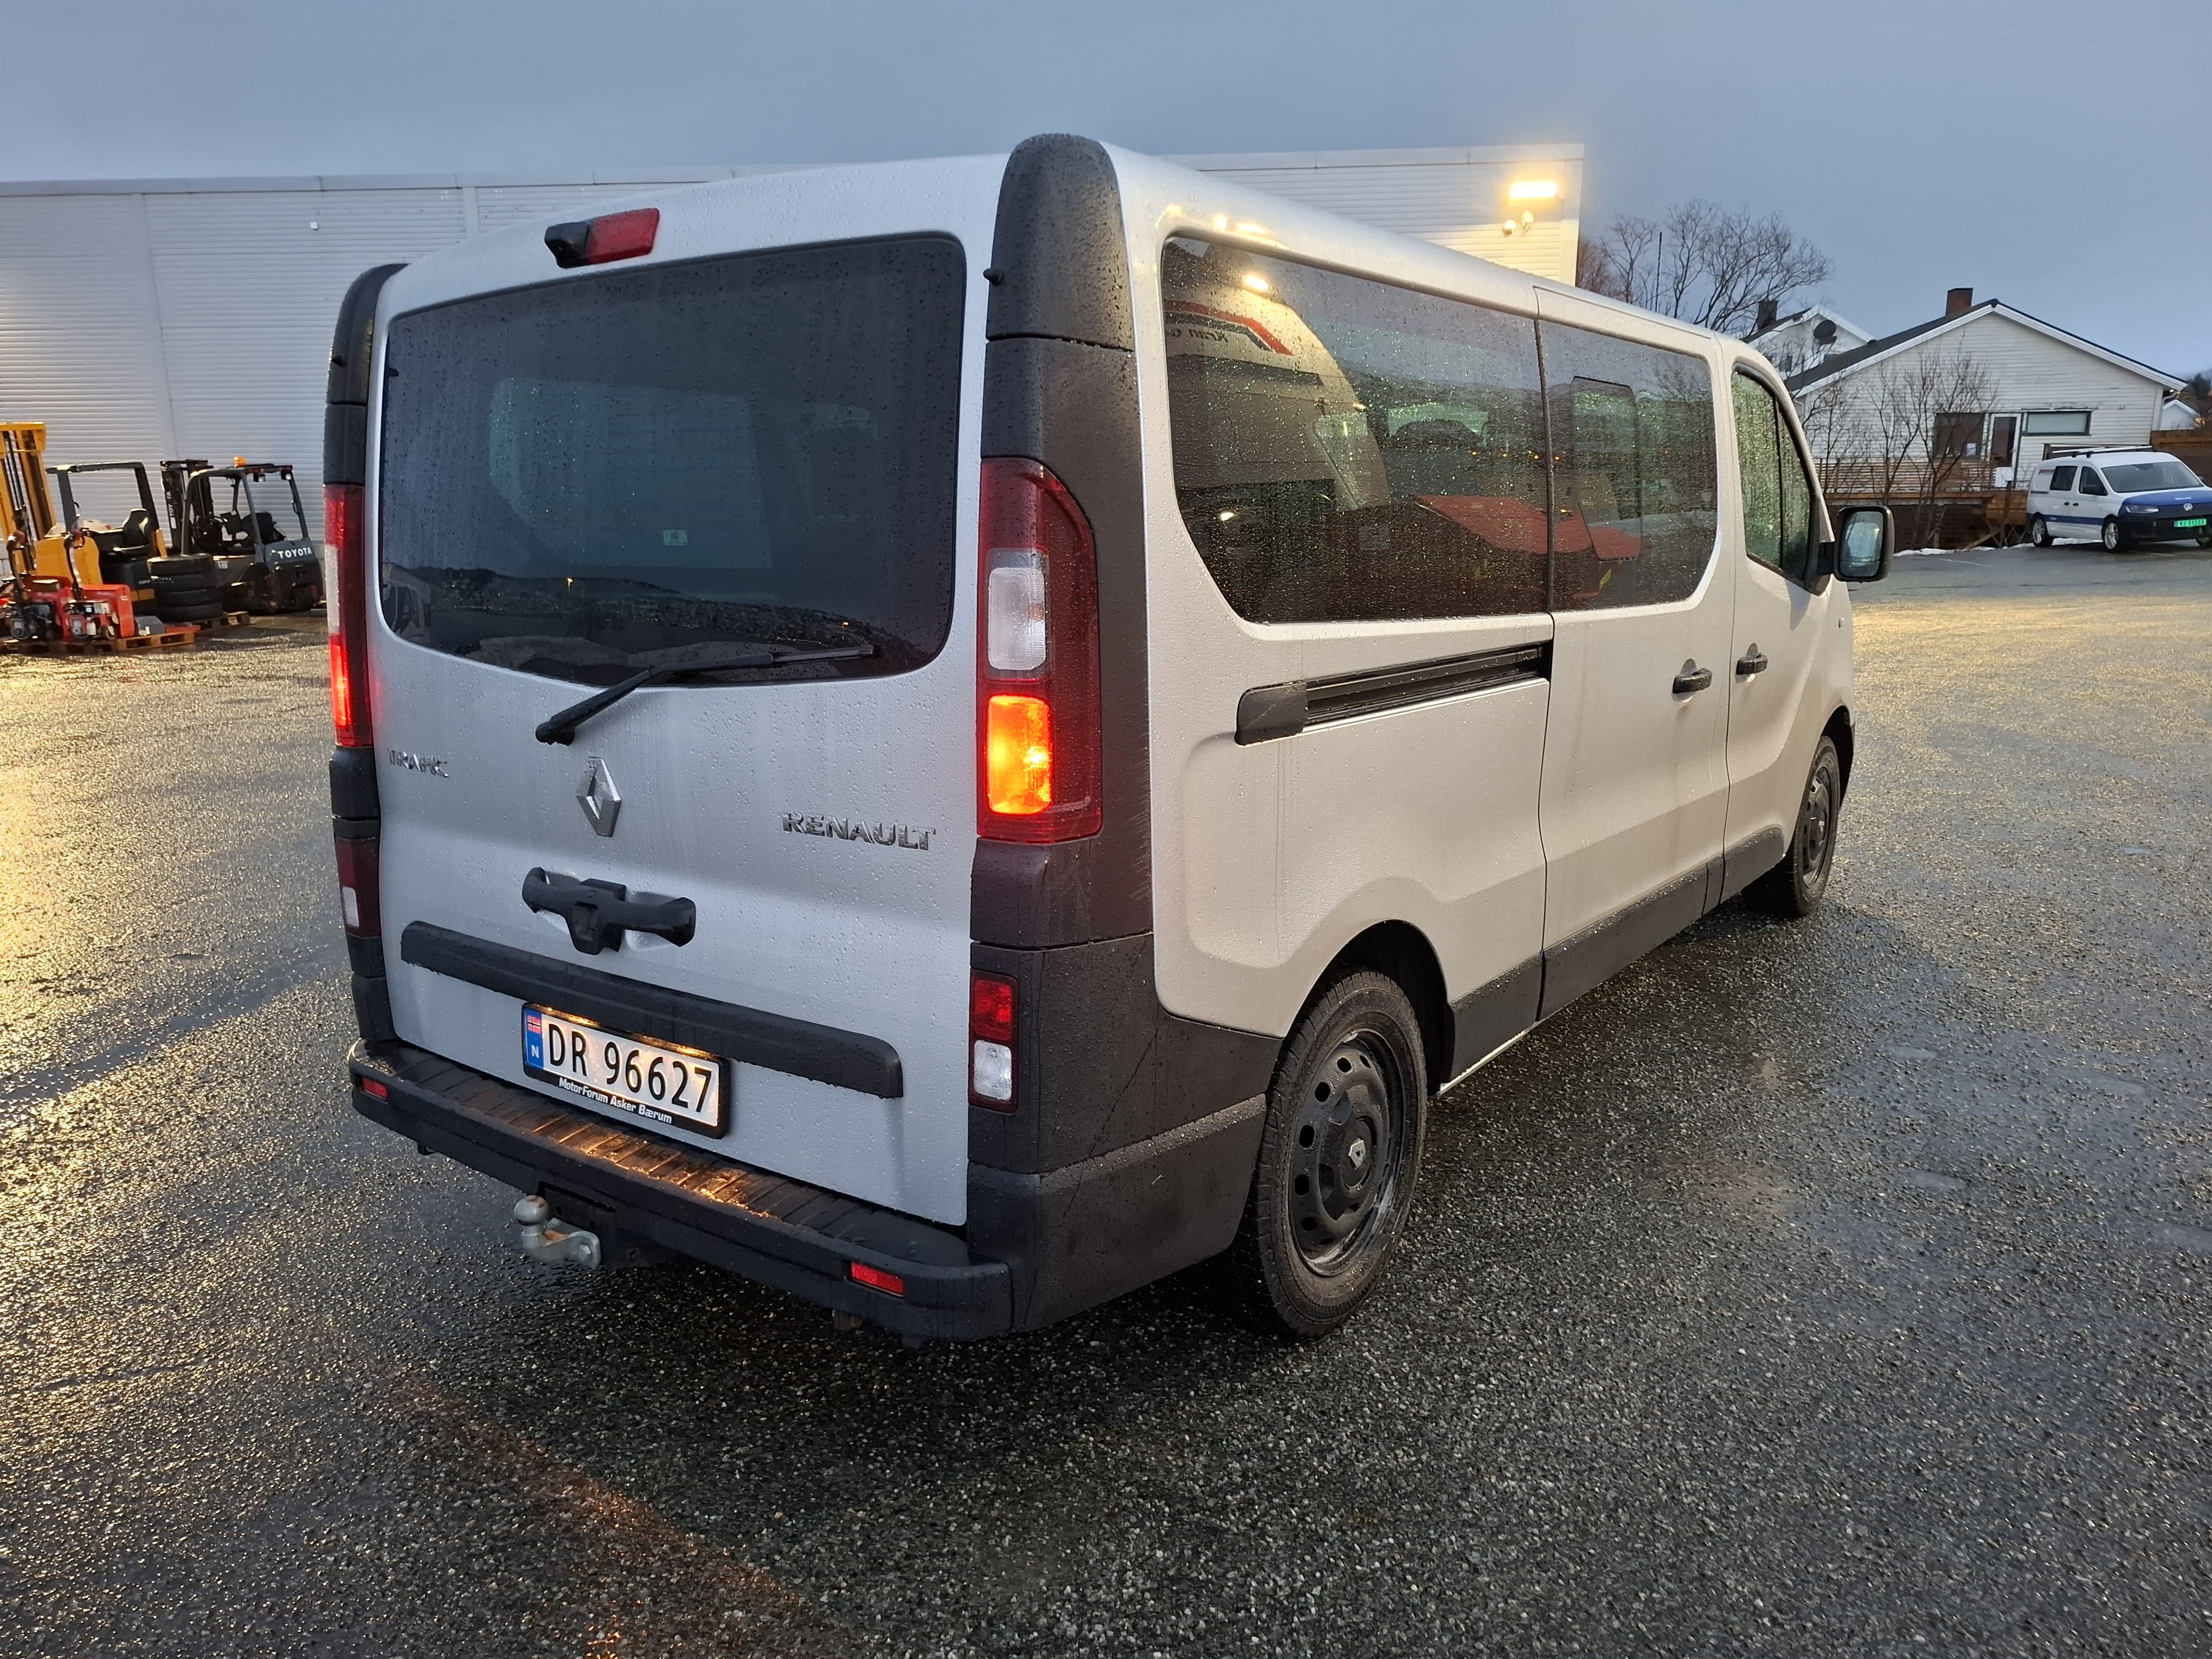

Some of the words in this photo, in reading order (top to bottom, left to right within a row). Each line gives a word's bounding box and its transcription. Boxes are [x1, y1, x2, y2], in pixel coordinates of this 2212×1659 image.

[166, 491, 175, 518] TOYTA
[277, 546, 312, 559] TOYOTA
[782, 811, 936, 851] RENAULT
[531, 1044, 539, 1058] N
[549, 1024, 587, 1076] DR
[605, 1041, 712, 1113] 96627
[559, 1077, 608, 1104] MotorForum
[610, 1095, 636, 1112] Asker
[639, 1103, 672, 1124] Bærum
